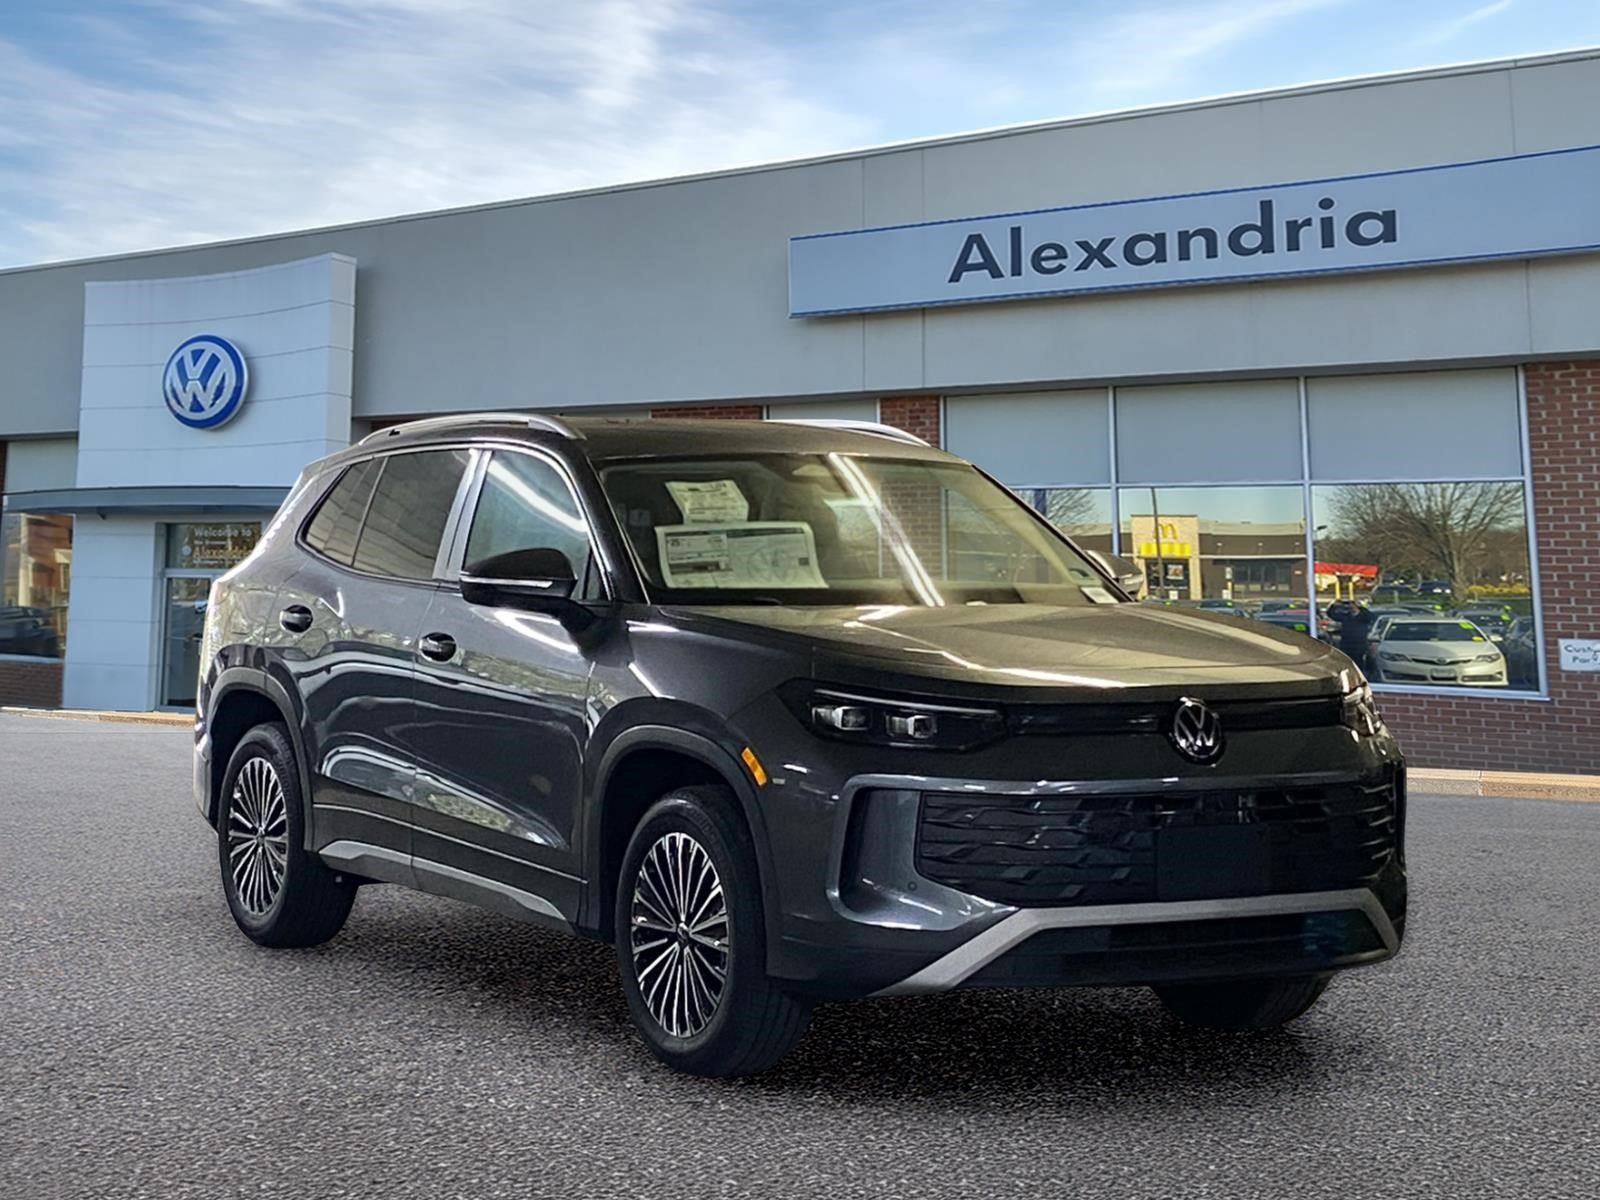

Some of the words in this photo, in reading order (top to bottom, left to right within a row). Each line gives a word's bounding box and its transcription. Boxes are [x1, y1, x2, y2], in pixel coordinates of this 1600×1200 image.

[947, 197, 1398, 284] Alexandria
[164, 341, 237, 421] VW
[1174, 702, 1219, 758] VW
